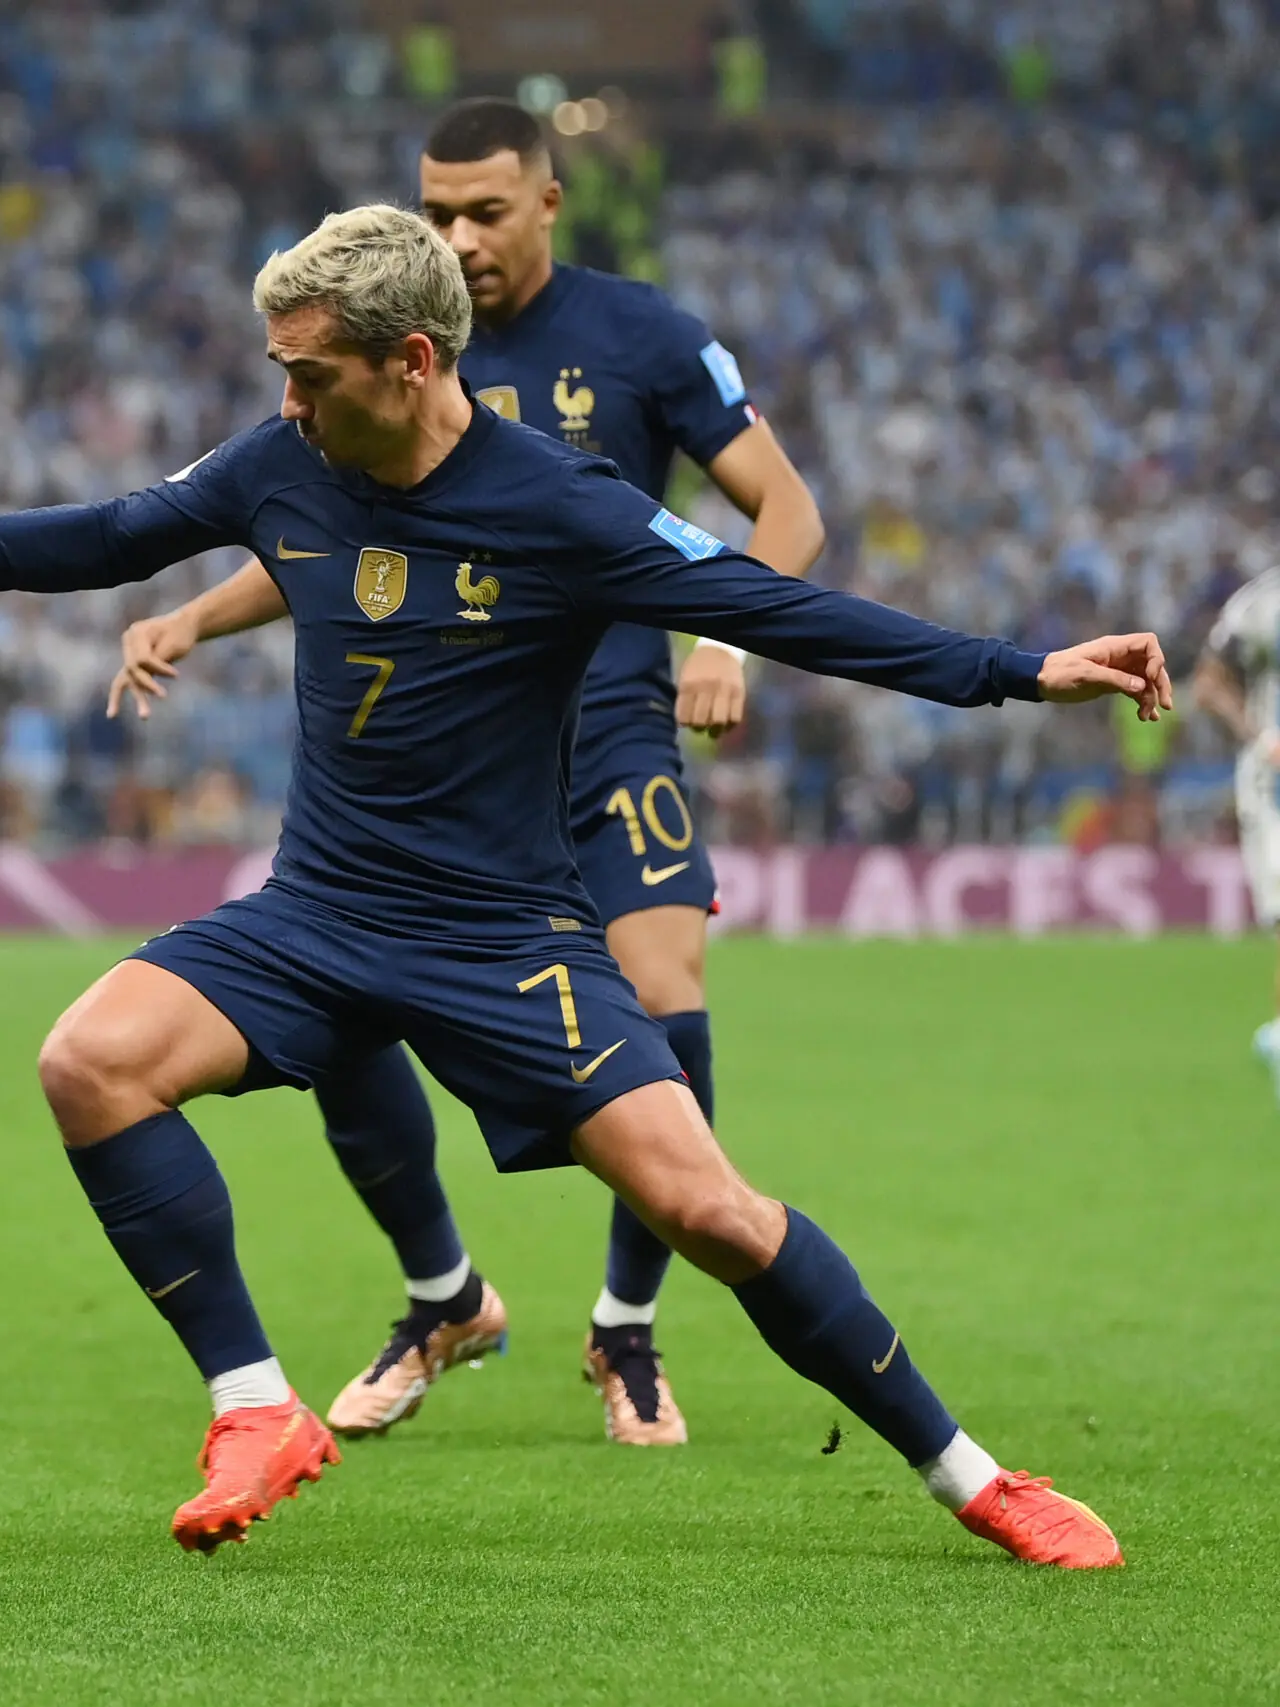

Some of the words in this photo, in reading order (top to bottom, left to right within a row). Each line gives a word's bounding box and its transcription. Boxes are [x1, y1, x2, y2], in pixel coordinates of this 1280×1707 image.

[368, 593, 390, 603] FIFA
[345, 653, 395, 738] 7
[605, 775, 693, 856] 10
[516, 963, 581, 1048] 7
